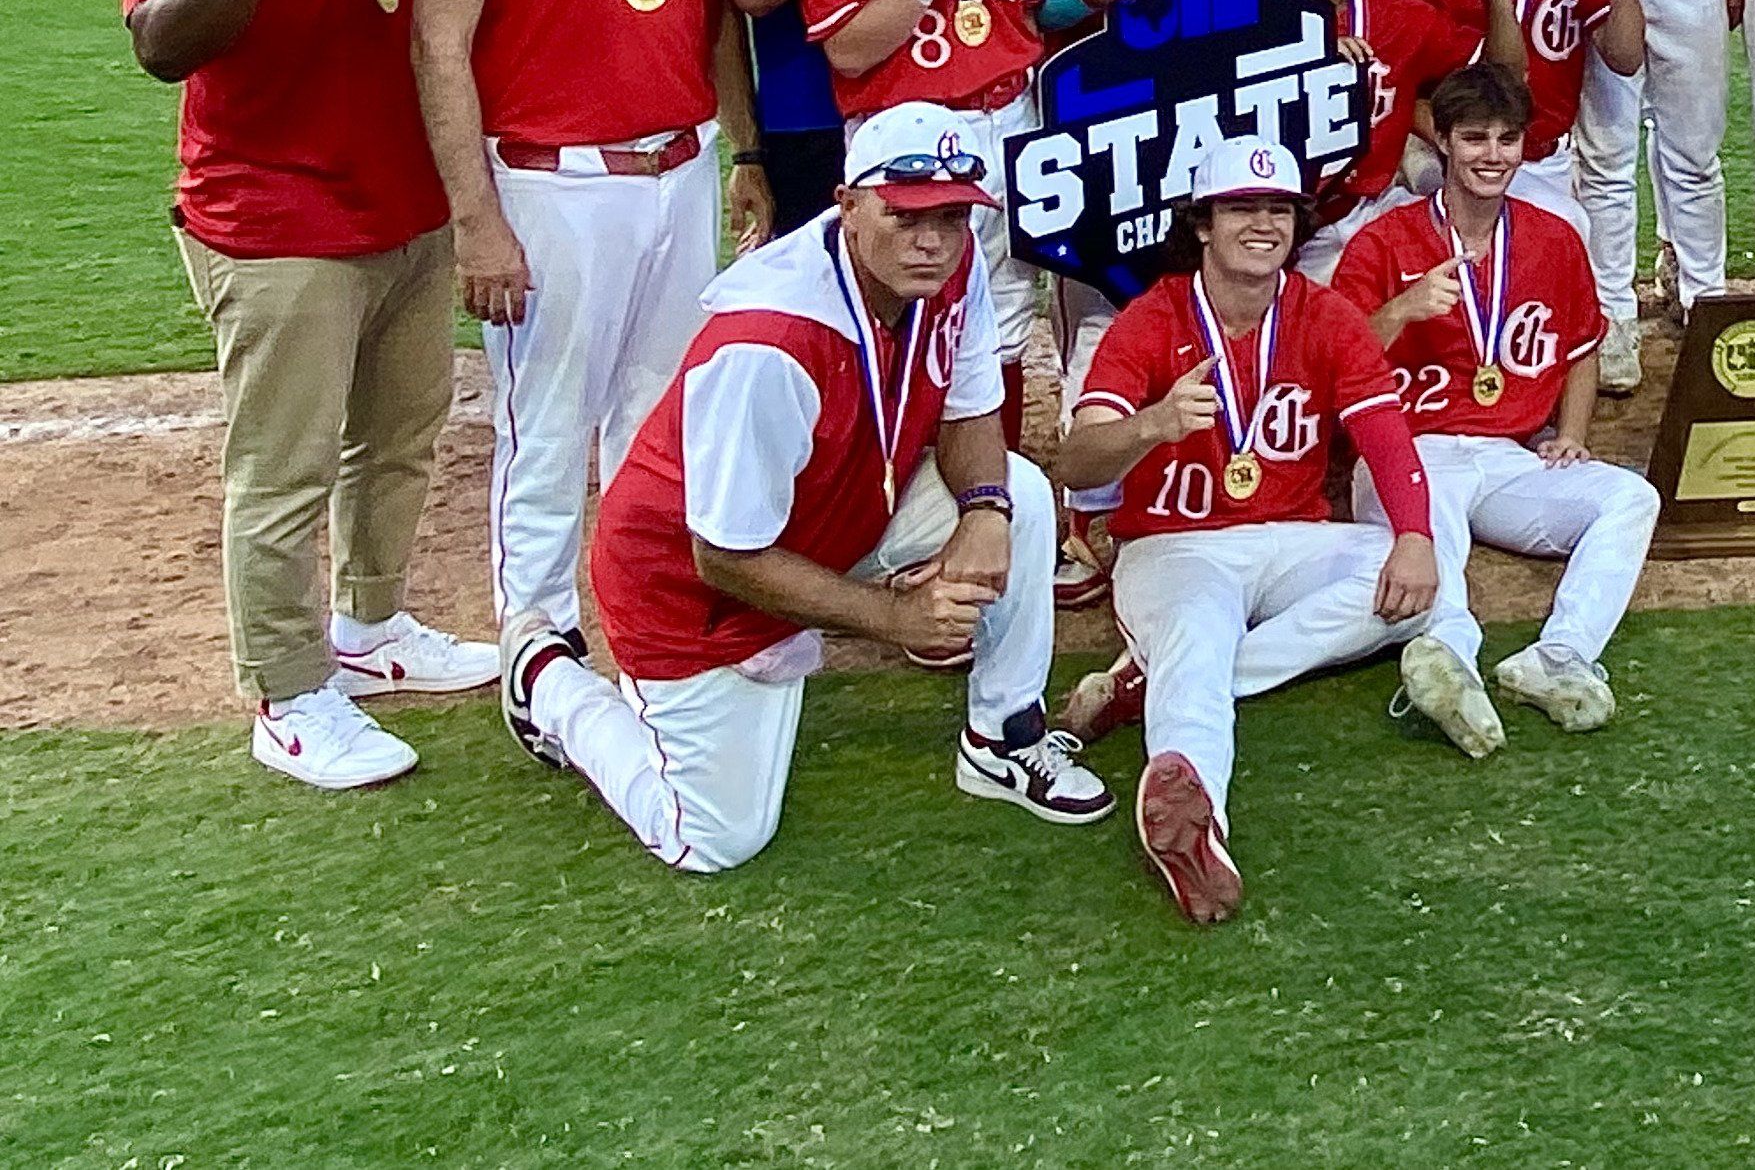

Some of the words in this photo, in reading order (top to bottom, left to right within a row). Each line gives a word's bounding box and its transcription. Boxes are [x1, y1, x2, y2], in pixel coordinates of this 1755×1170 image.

[911, 9, 951, 69] 8
[1015, 63, 1359, 239] STATE
[1391, 364, 1451, 414] 22
[1146, 459, 1214, 520] 10
